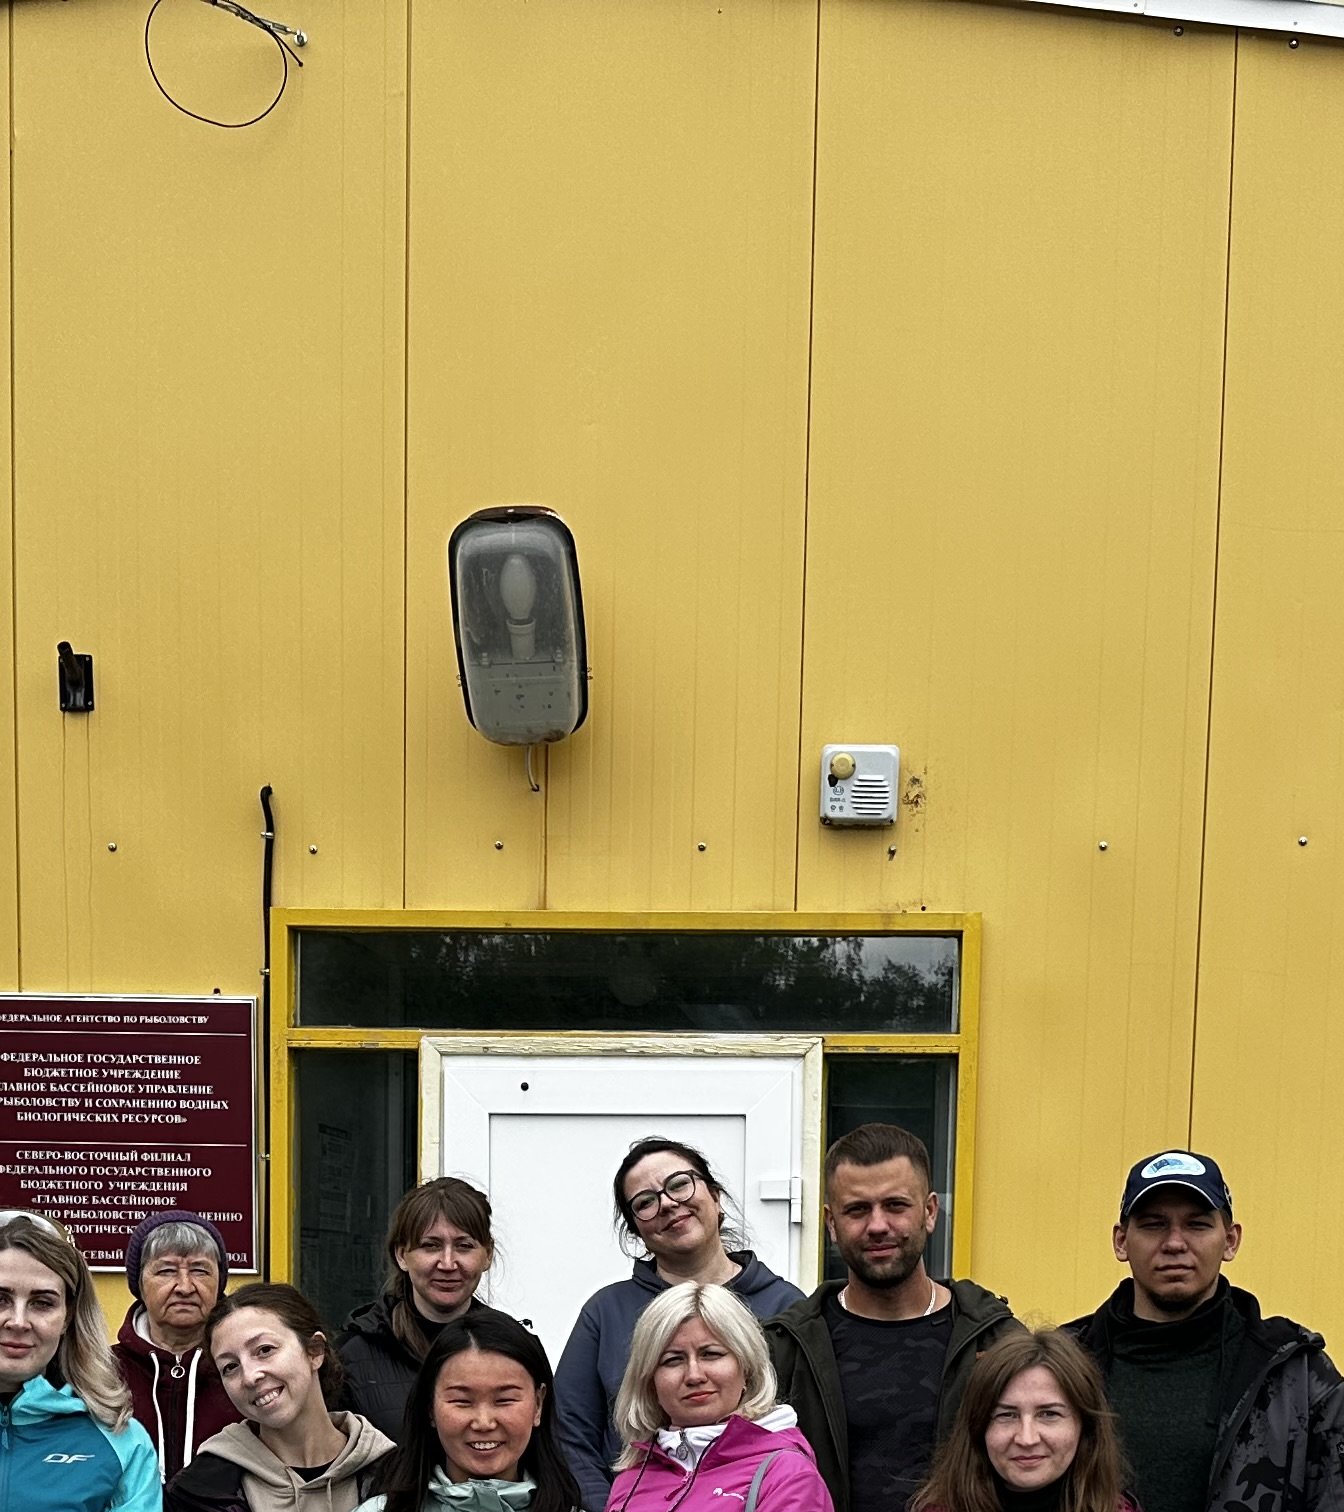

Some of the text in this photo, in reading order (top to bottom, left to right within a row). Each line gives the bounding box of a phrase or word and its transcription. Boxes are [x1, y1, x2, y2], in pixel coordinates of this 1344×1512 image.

[1, 1053, 201, 1064] ФЕДЕРАЛЬНОЕ ГОСУДАРСТВЕННОЕ
[24, 1068, 181, 1079] БЮДЖЕТНОЕ УЧРЕЖДЕНИЕ
[50, 1082, 135, 1093] БАССЕЙНОВОЕ
[138, 1085, 213, 1094] УПРАВЛЕНИЕ
[85, 1099, 92, 1107] И
[96, 1099, 176, 1108] СОХРАНЕНИЮ
[180, 1100, 228, 1109] ВОДНЫХ
[17, 1112, 187, 1123] БИОЛОГИЧЕСКИХ РЕСУРСОВ»
[16, 1150, 190, 1161] СЕВЕРО-ВОСТОЧНЫЙ ФИЛИАЛ
[90, 1166, 211, 1176] ГОСУДАРСТВЕННОГО
[21, 1180, 187, 1191] БЮДЖЕТНОГО УЧРЕЖДЕНИЯ
[32, 1195, 177, 1205] «ГЛАВНОЕ БАССЕЙНОВОЕ
[44, 1210, 61, 1221] ПО
[64, 1210, 148, 1219] РЫБОЛОВСТВУ
[198, 1212, 243, 1222] НЕНИЮ
